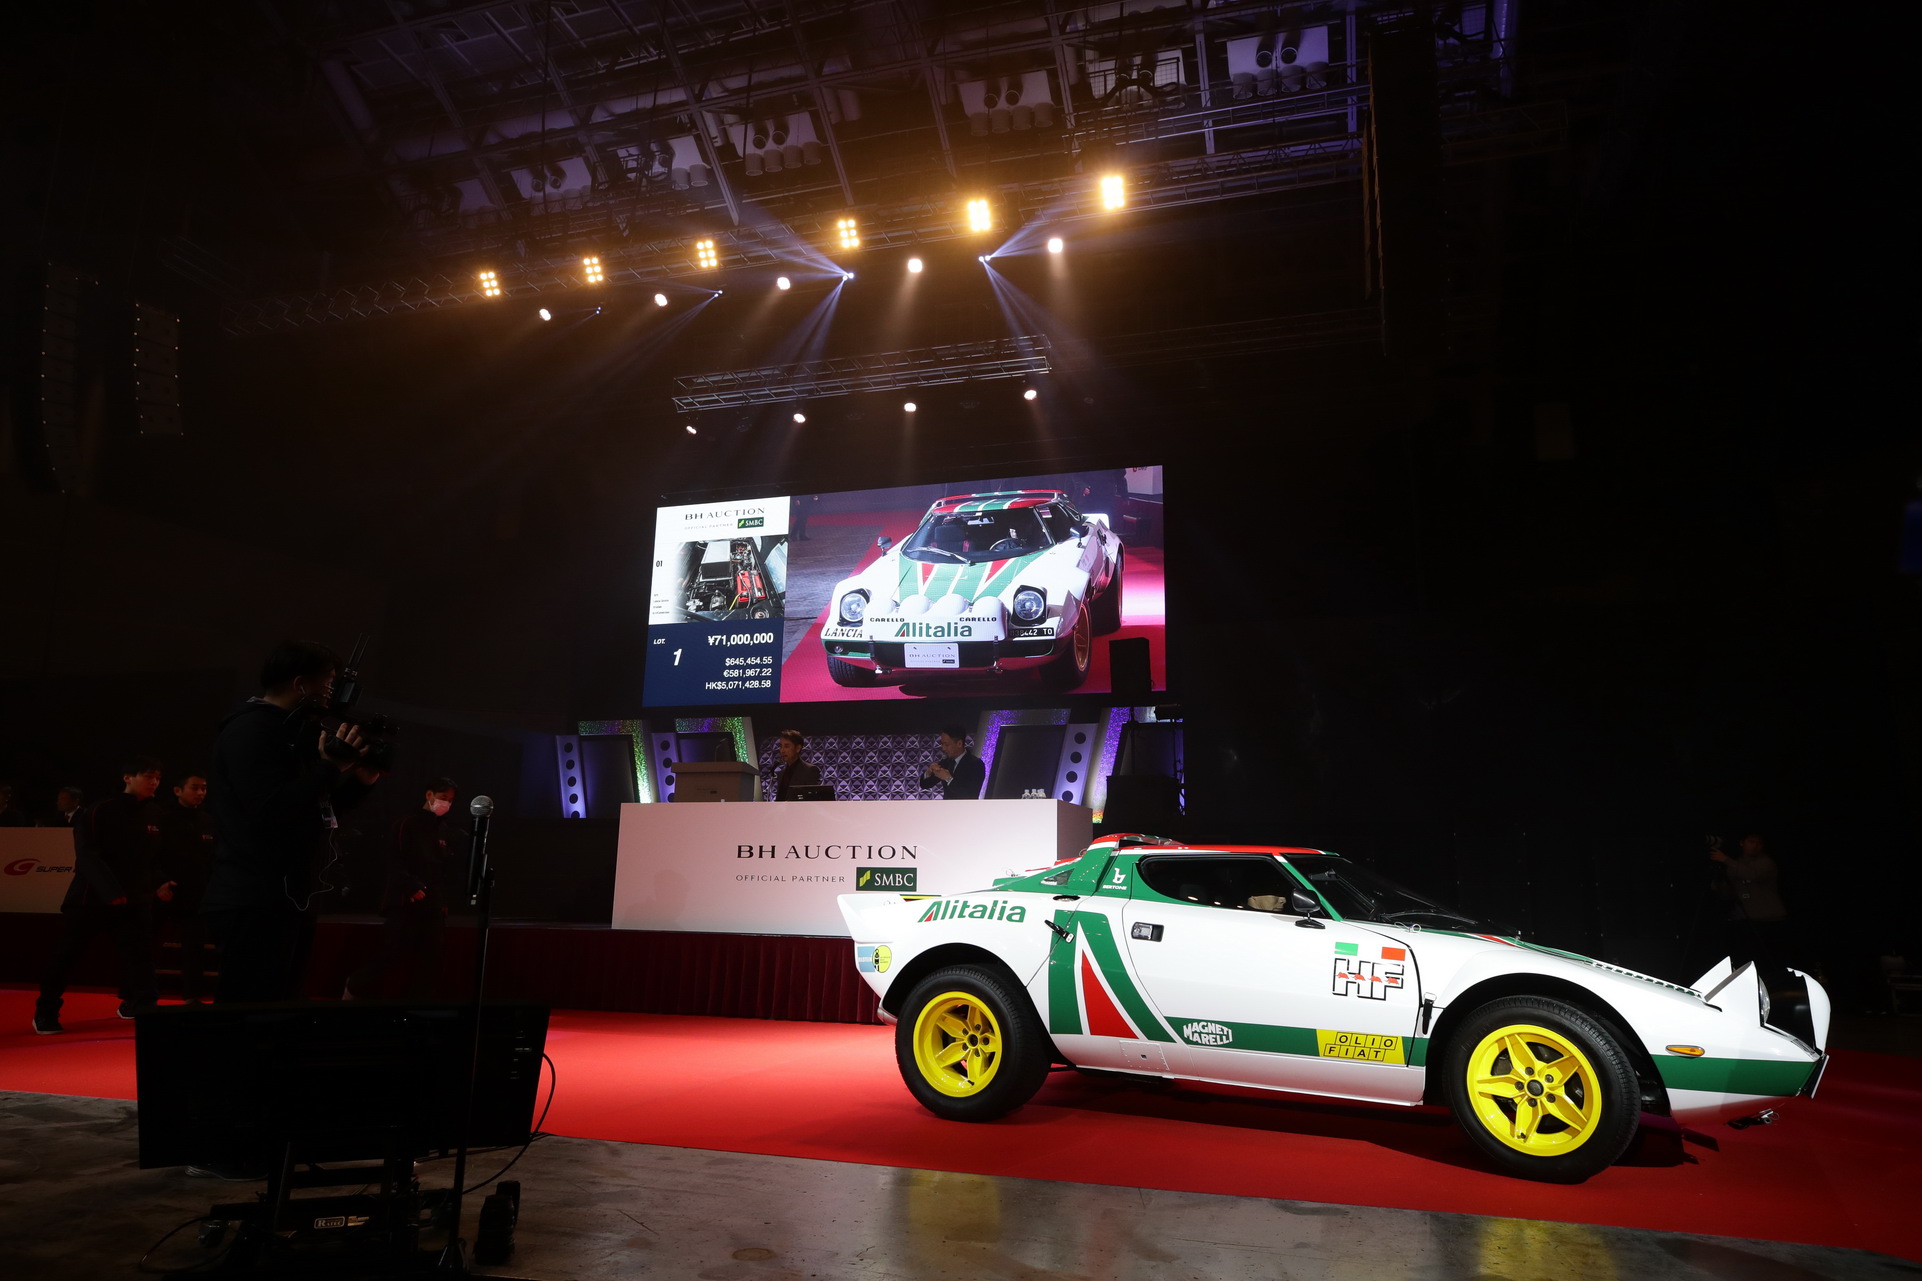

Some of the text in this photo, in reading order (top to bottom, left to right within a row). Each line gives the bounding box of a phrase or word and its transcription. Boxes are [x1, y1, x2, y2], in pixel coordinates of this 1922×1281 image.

[706, 507, 765, 518] AUCTION
[745, 518, 763, 526] SMBC
[824, 627, 863, 638] LANCIA
[894, 622, 972, 638] Alitalia
[707, 632, 774, 647] ¥71,000,000
[673, 648, 682, 666] 1
[725, 656, 773, 667] $645,454.55
[723, 668, 772, 678] €581,967.22
[705, 680, 772, 690] HK$5,071,428.58
[736, 844, 918, 860] BH AUCTION
[735, 874, 845, 883] OFFICIAL PARTNER
[874, 873, 914, 887] SMBC
[917, 900, 1026, 923] Alitalia
[1332, 957, 1405, 1001] HF
[1183, 1021, 1233, 1037] MAGNETI
[1183, 1031, 1233, 1045] MARELLI
[1338, 1034, 1394, 1047] OLIO
[1328, 1045, 1382, 1059] FIAT
